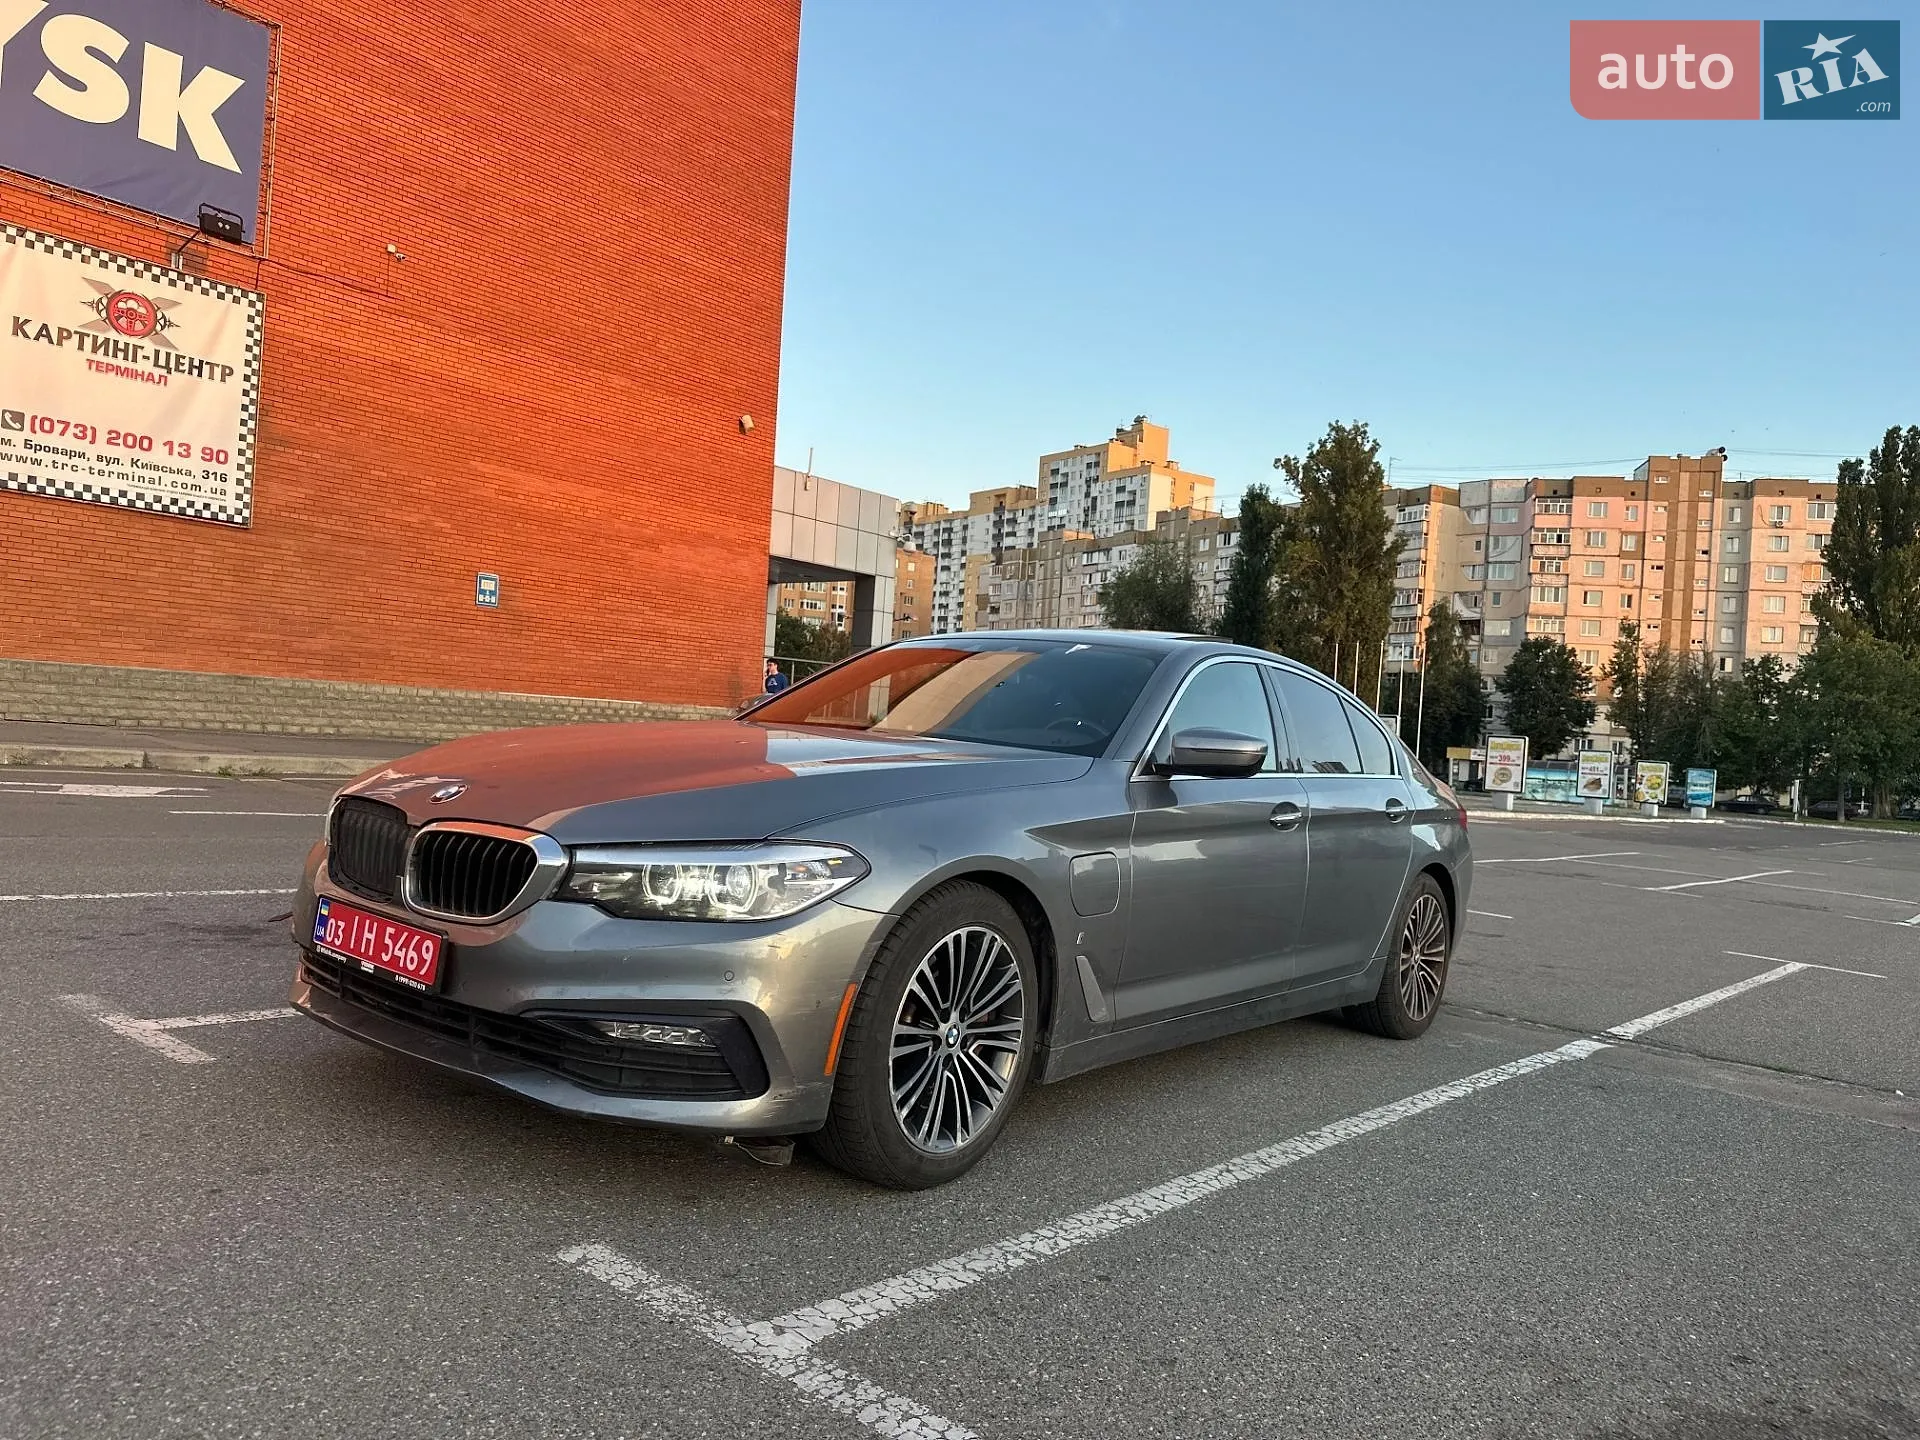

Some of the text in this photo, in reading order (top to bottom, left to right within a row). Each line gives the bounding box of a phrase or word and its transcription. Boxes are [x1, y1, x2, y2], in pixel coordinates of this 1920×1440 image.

[11, 315, 234, 383] КАРТИНГ-ЦЕНТР
[86, 358, 168, 387] ТЕРМІНАЛ
[24, 438, 90, 461] Бровари,
[96, 454, 124, 467] вул.
[130, 458, 196, 479] Київська,
[201, 469, 228, 482] 316
[30, 414, 229, 465] (073) 200 13 90
[0, 452, 227, 496] www.trc-terminal.com.ua
[316, 925, 325, 938] UA
[326, 918, 345, 946] 03
[381, 927, 434, 976] 5469
